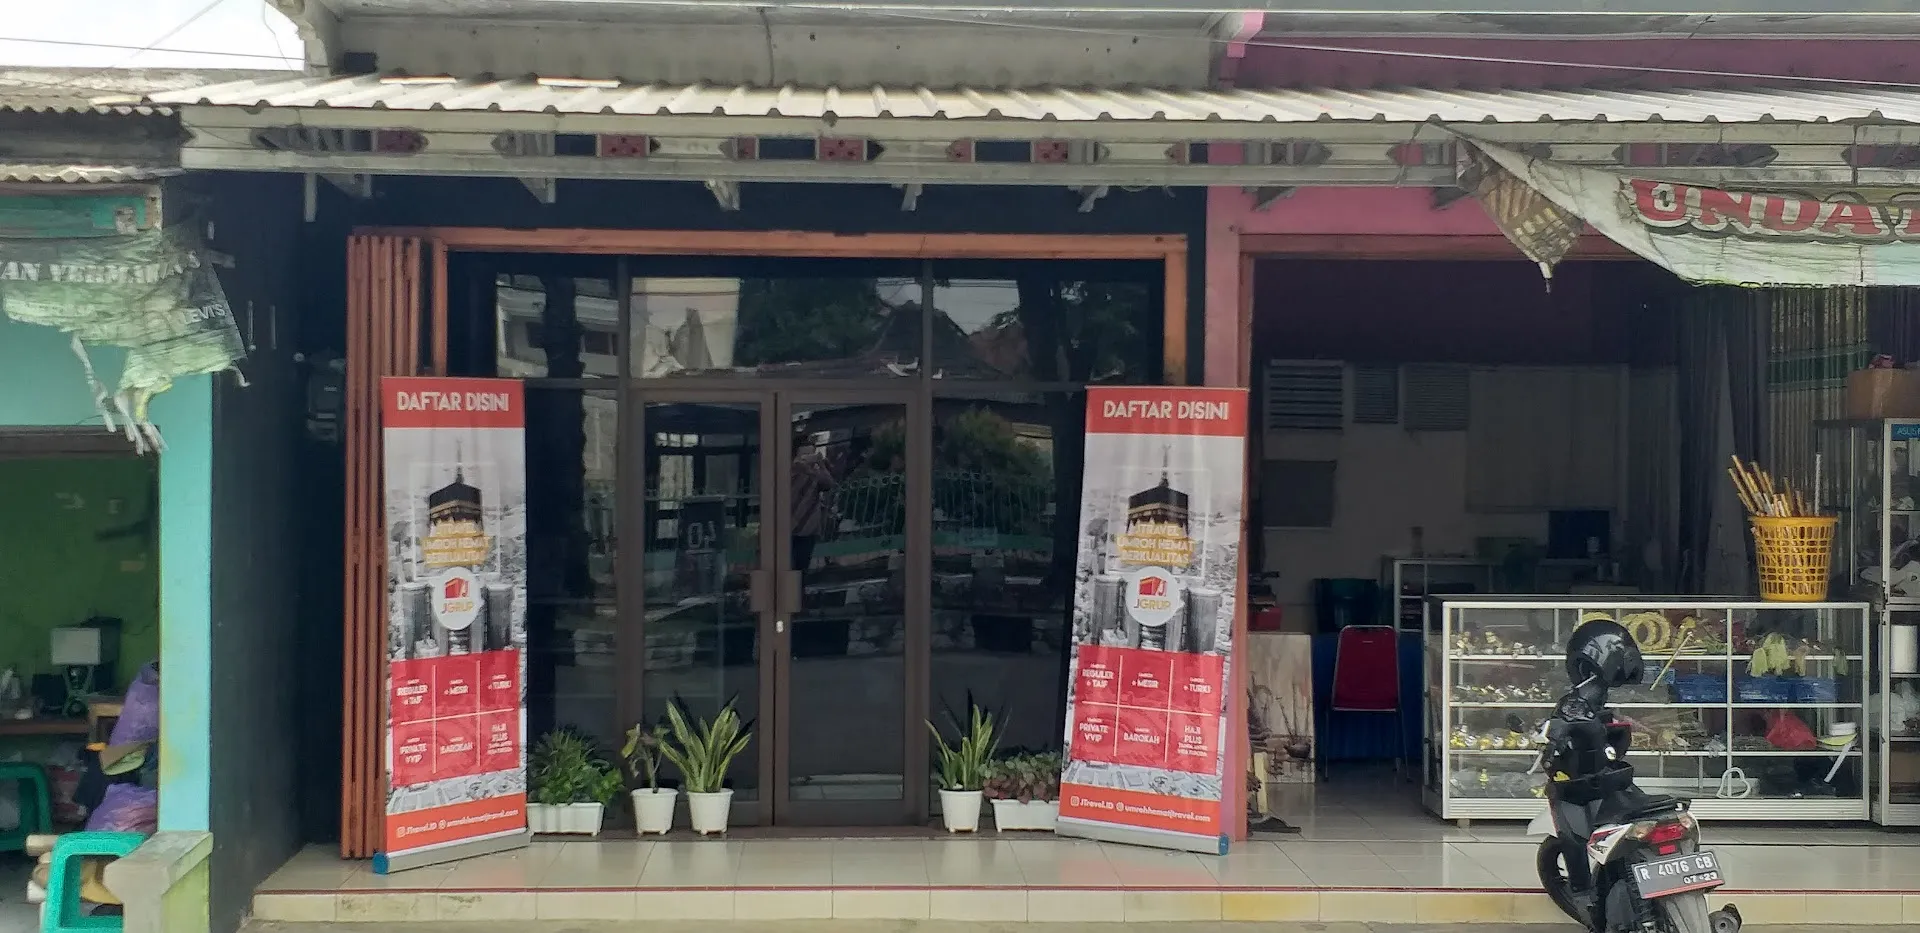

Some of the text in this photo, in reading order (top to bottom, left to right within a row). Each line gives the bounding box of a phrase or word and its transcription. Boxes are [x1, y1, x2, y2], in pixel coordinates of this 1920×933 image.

[0, 260, 41, 281] AN
[396, 391, 510, 412] DAFTAR DISINI
[1103, 399, 1230, 421] DAFTAR DISINI
[1157, 539, 1196, 552] HEMAT
[1121, 550, 1189, 563] BERKUALITAS
[1133, 598, 1172, 611] JGRUP
[1079, 722, 1109, 734] PRIVATE
[1123, 732, 1161, 745] BAROKAH
[1184, 735, 1203, 745] PLUS
[1640, 855, 1714, 881] R 4076 CB
